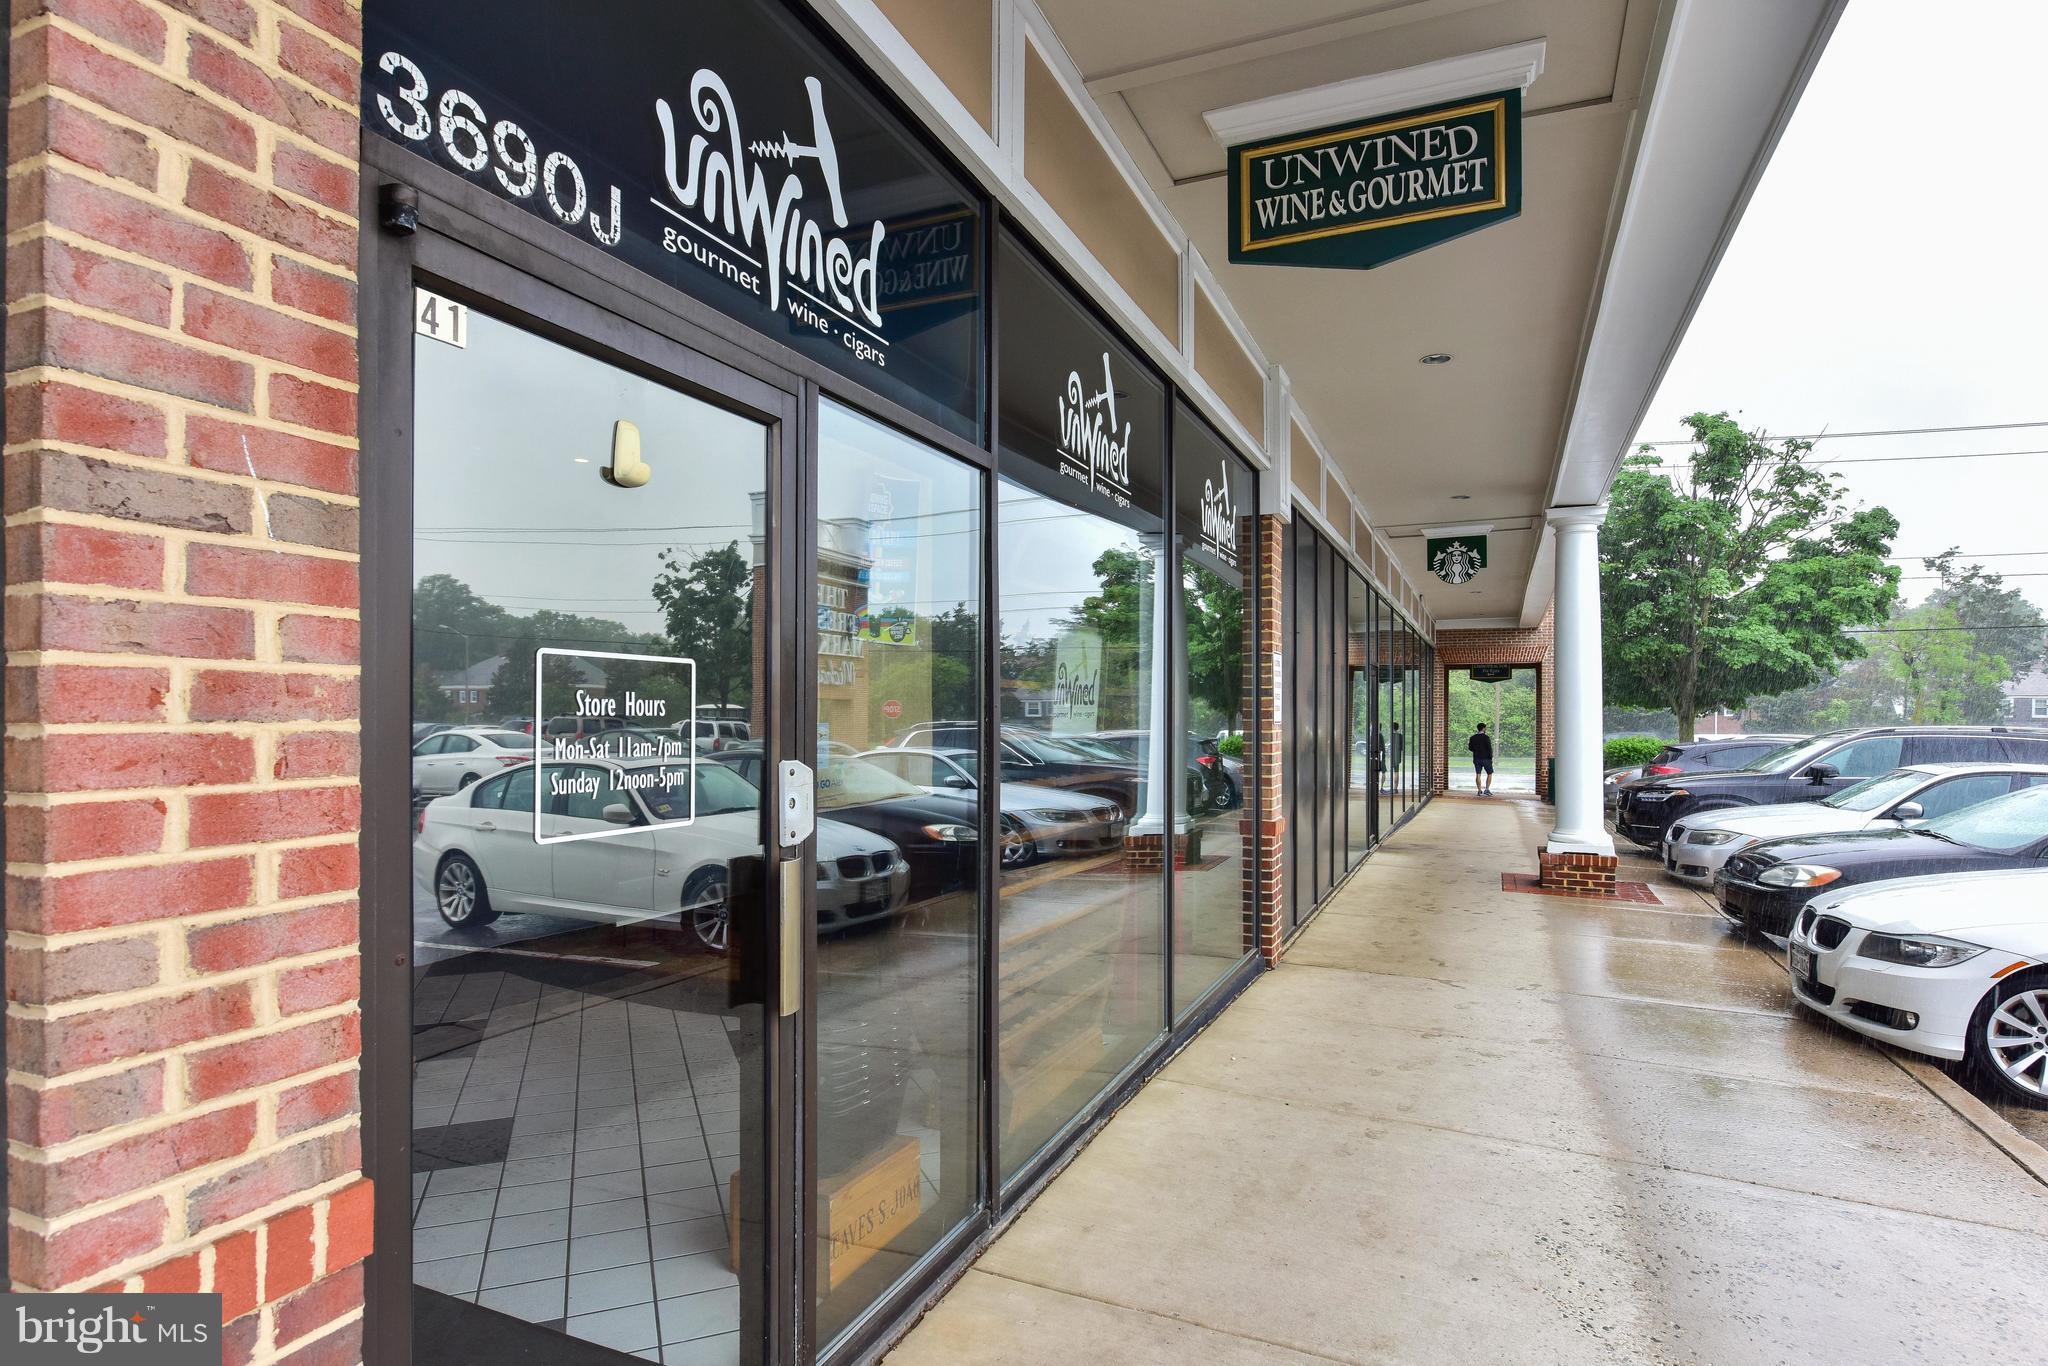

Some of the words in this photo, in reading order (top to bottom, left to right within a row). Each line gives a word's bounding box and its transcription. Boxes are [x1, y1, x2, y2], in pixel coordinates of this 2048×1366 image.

[376, 51, 622, 246] 3690J
[1261, 125, 1479, 190] UNWINED
[663, 226, 760, 295] gourmet
[421, 296, 459, 342] 41
[786, 298, 828, 334] wine
[843, 332, 885, 367] cigars
[1060, 461, 1089, 485] gourmet
[1096, 482, 1111, 497] wine
[1114, 492, 1131, 508] cigars
[576, 689, 616, 717] Store
[625, 691, 666, 717] Hours
[555, 737, 610, 761] Mon-Sat
[619, 735, 682, 762] 11am-7pm
[551, 772, 600, 799] Sunday
[609, 766, 684, 793] 12noon-5pm
